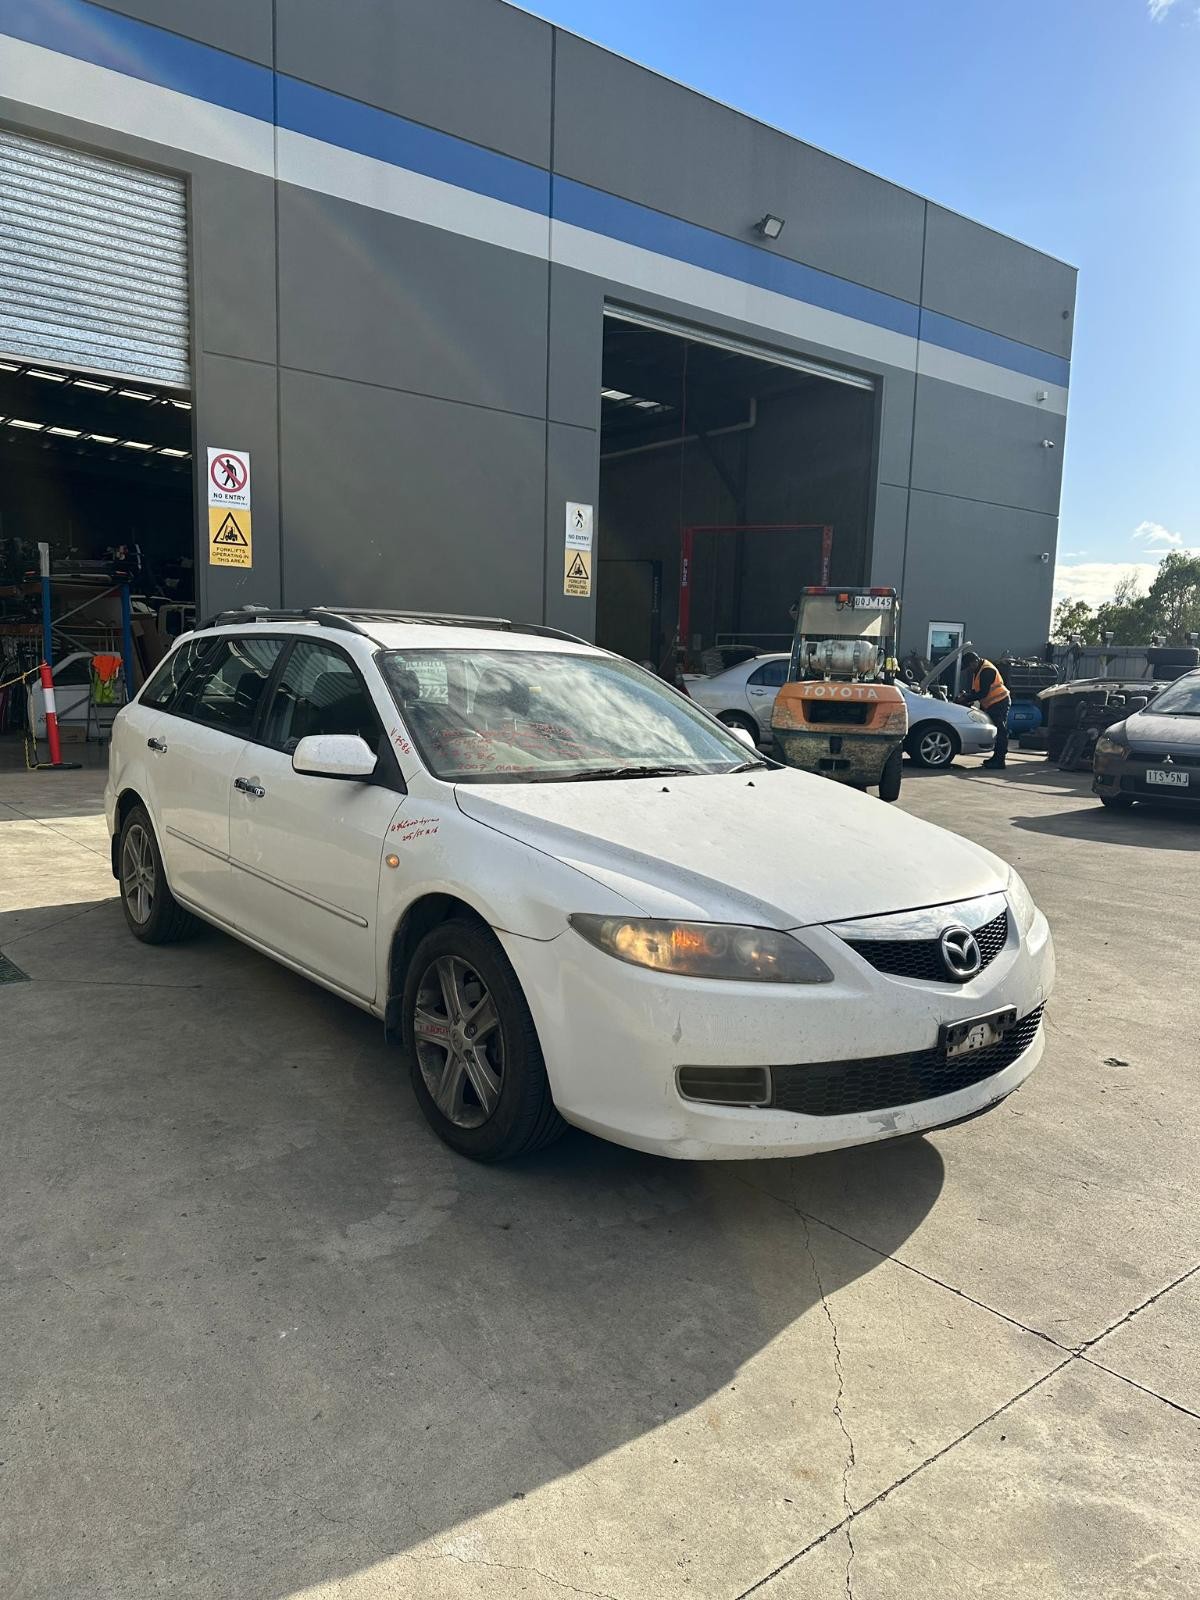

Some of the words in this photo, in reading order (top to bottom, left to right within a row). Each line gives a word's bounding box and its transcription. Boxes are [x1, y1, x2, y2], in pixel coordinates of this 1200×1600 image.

[224, 493, 246, 501] ENTRY
[876, 597, 891, 607] 145
[803, 685, 879, 699] TOYOTA
